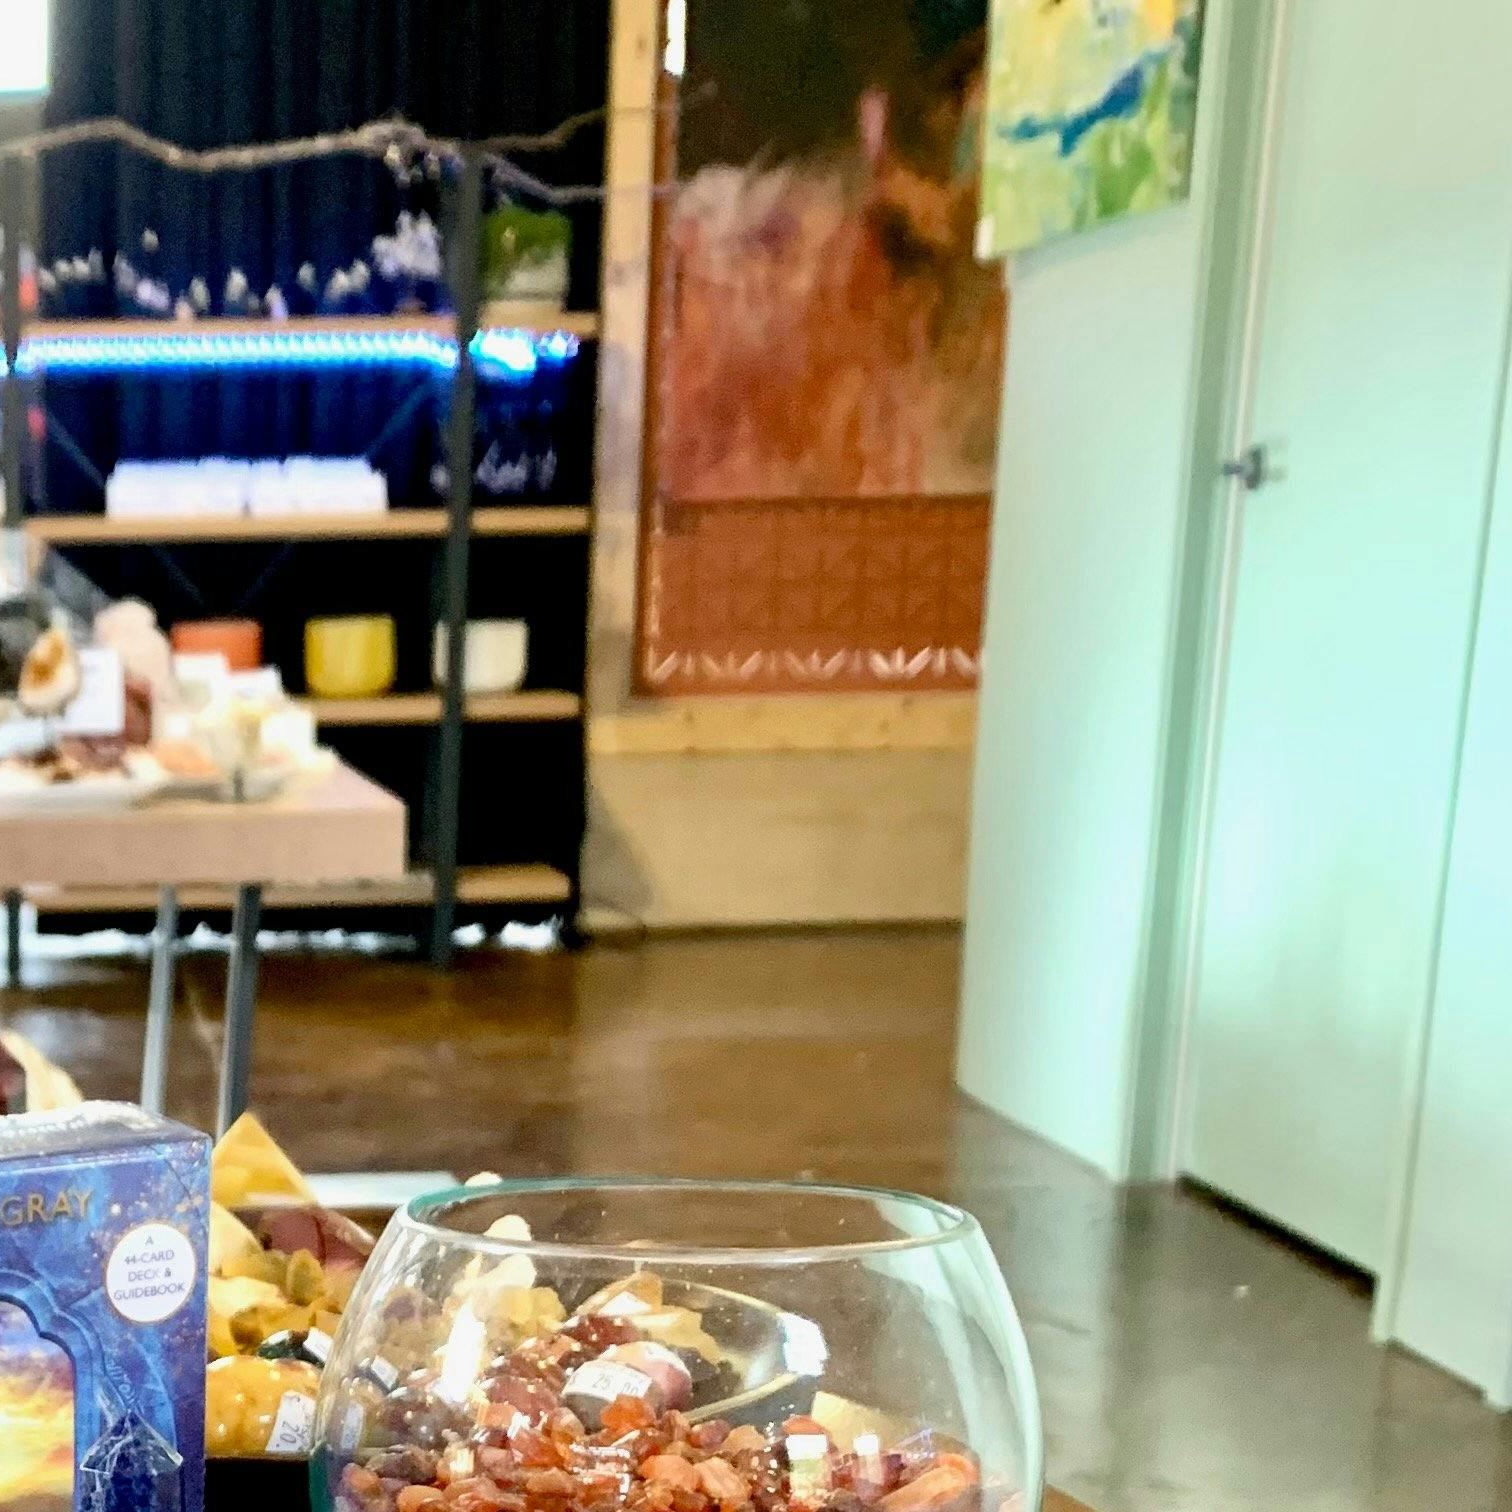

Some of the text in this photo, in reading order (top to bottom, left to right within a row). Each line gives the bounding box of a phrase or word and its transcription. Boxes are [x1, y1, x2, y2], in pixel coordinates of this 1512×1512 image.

[145, 1235, 154, 1246] A
[124, 1249, 175, 1265] 44-CARD
[128, 1266, 172, 1281] DECK &
[114, 1282, 185, 1300] GUIDEBOOK
